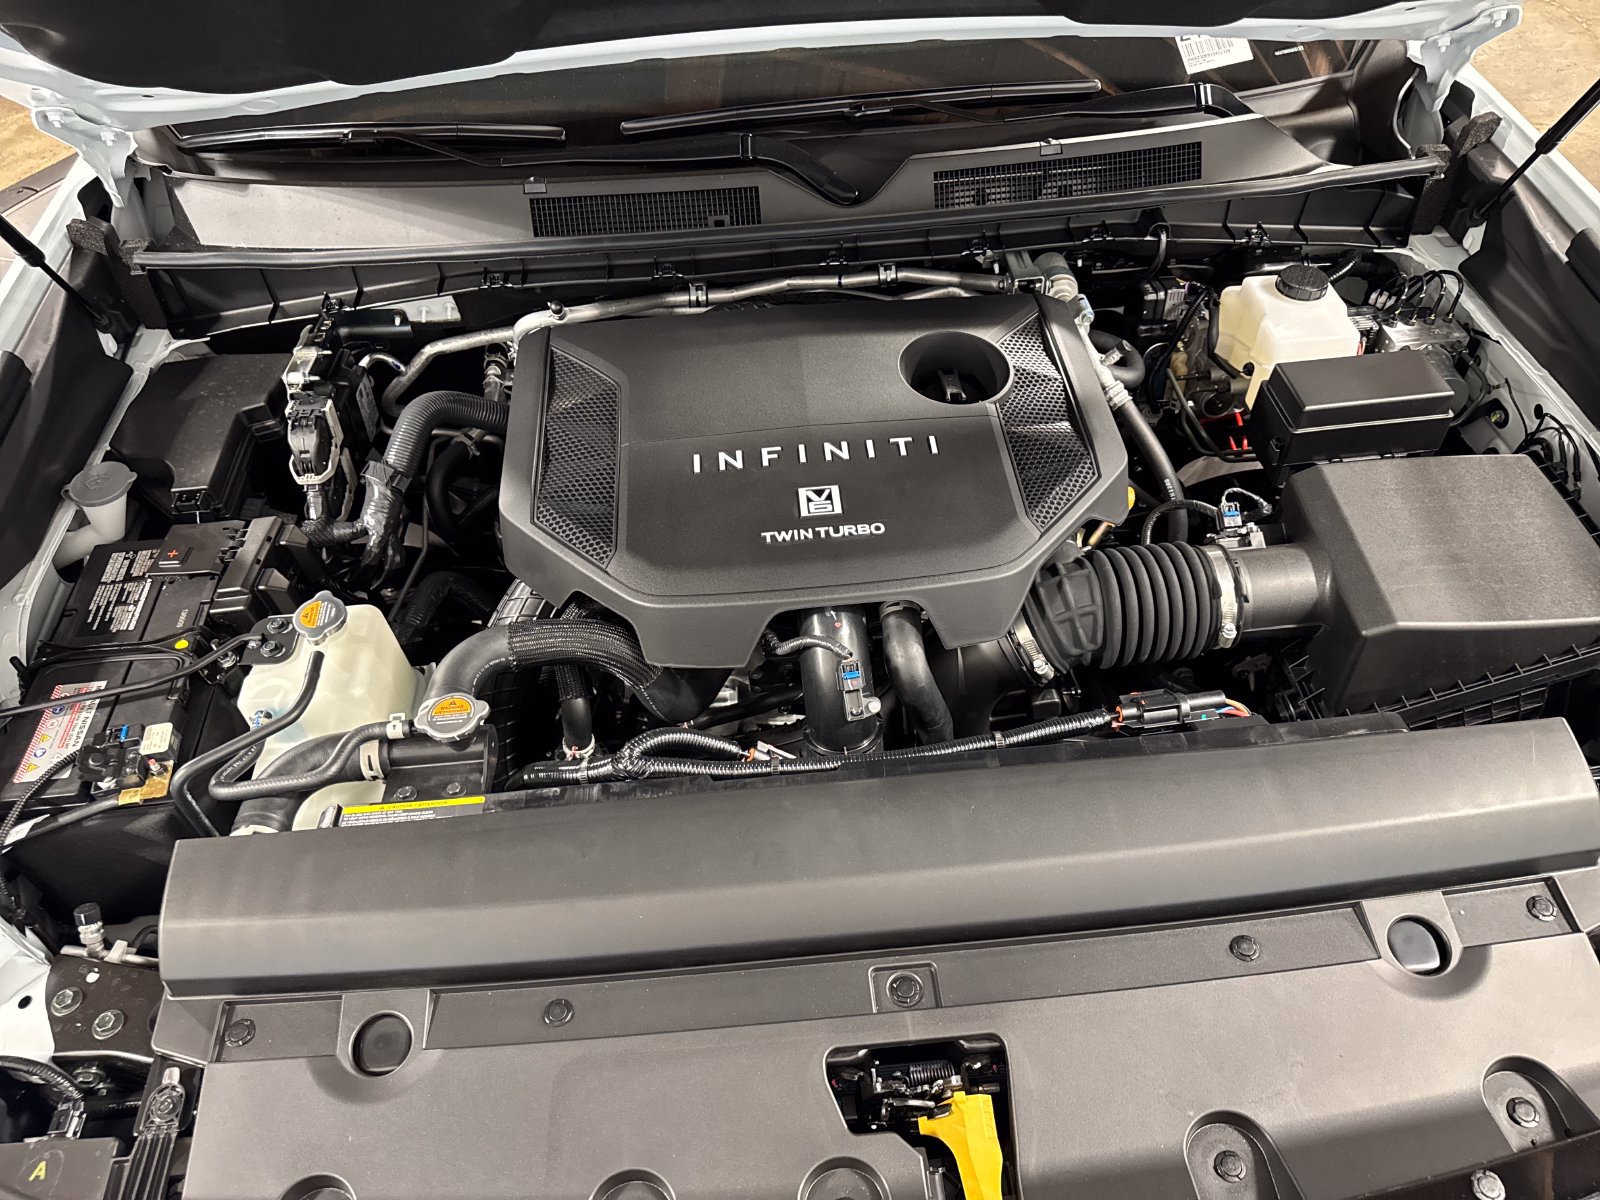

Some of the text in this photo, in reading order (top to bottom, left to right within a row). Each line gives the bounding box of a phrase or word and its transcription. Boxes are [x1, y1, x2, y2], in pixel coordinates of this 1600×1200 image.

[692, 435, 939, 474] INFINITI
[761, 522, 886, 544] TWIN TURBO
[72, 716, 90, 747] NISSAN
[28, 1160, 47, 1182] A
